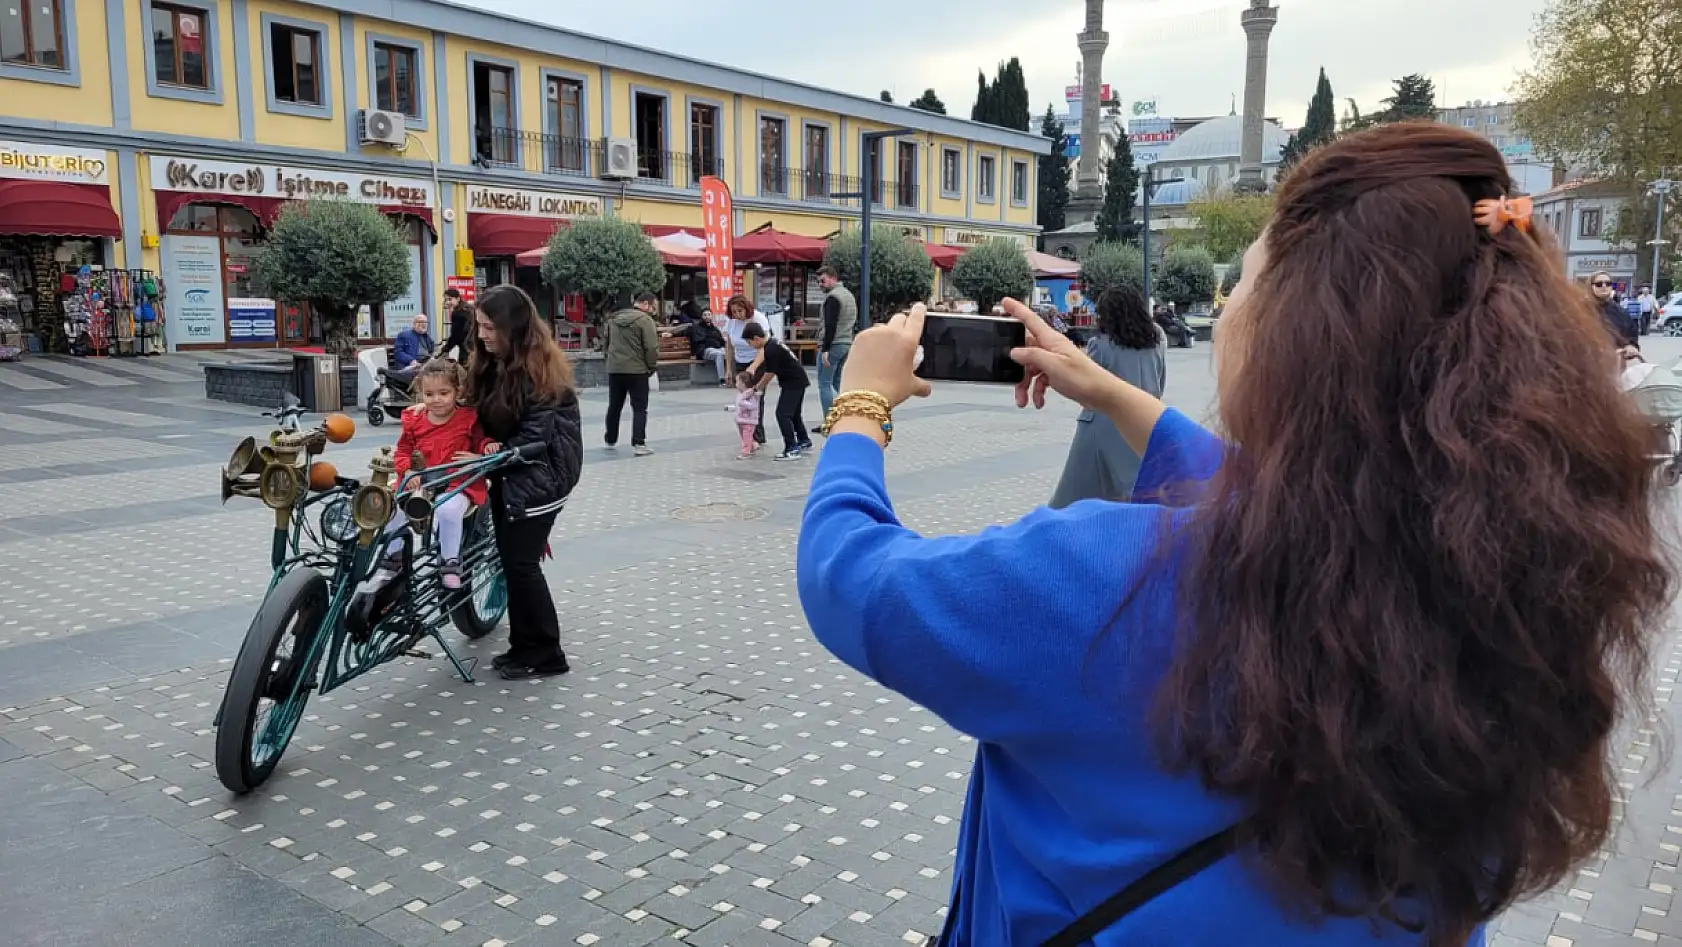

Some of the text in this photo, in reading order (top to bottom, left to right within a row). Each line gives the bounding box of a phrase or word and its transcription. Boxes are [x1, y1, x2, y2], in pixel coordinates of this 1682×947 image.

[276, 167, 349, 197] İşitme
[470, 188, 598, 215] HÂNEGÂH LOKANTASI
